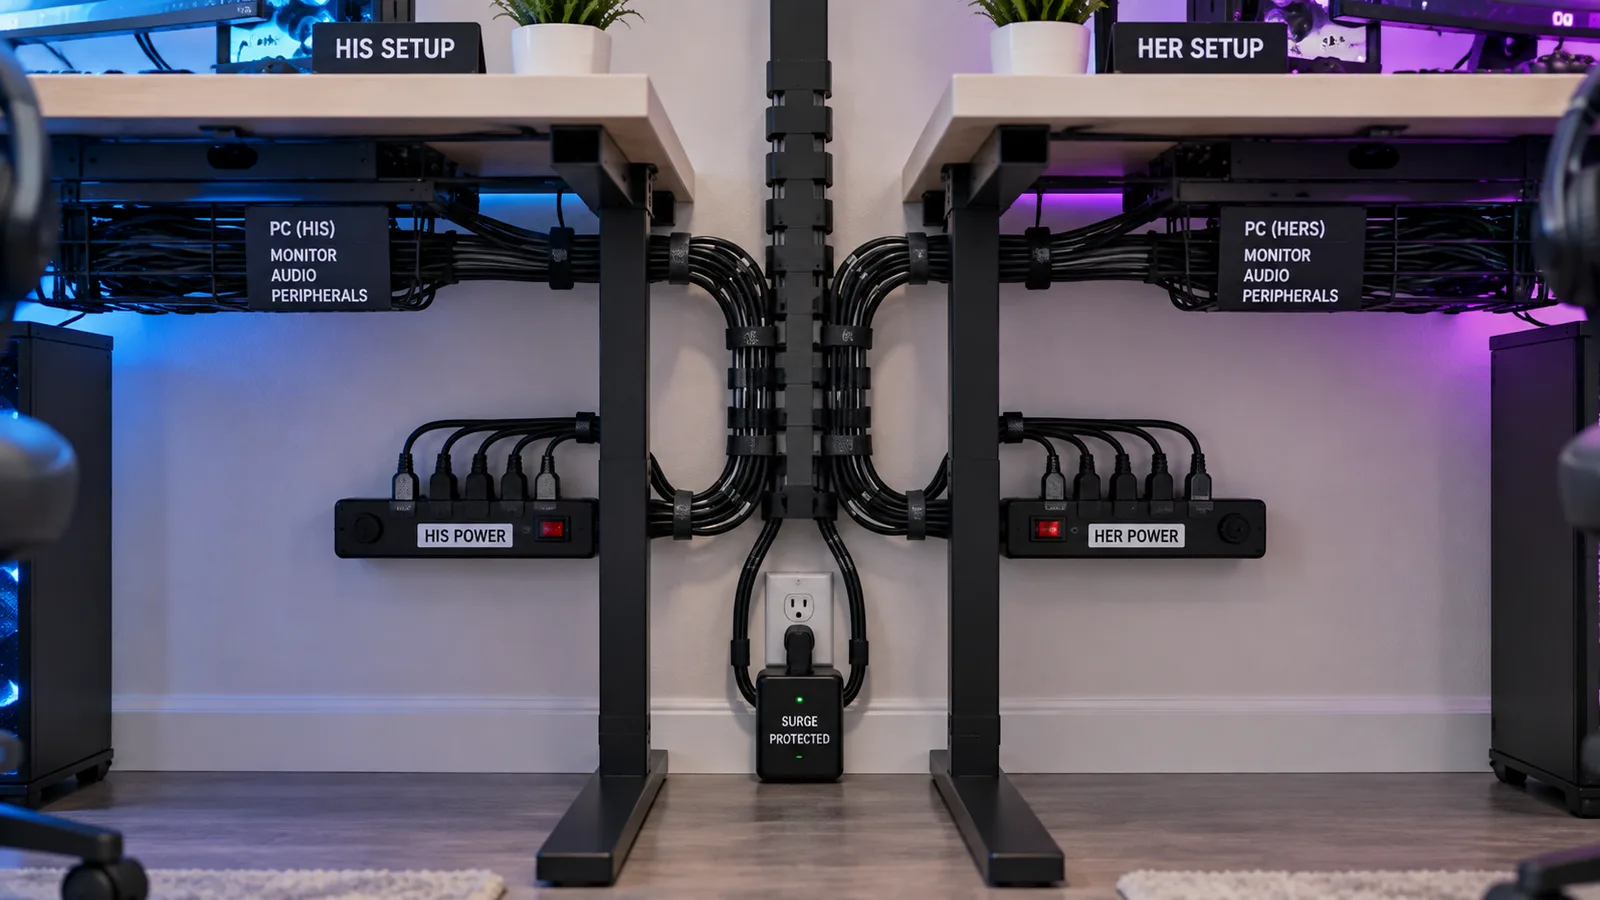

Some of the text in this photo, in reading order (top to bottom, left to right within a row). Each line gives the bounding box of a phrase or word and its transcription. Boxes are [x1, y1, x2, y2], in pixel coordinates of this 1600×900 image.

[336, 37, 455, 60] HIS SETUP
[1138, 37, 1264, 60] HER SETUP
[269, 219, 336, 239] PC (HIS)
[1244, 219, 1326, 239] PC (HERS)
[270, 248, 337, 263] MONITOR
[1243, 248, 1311, 263] MONITOR
[270, 268, 317, 282] AUDIO
[1243, 268, 1290, 283] AUDIO
[271, 288, 368, 304] PERIPHERALS
[1242, 288, 1339, 304] PERIPHERALS
[425, 529, 506, 543] HIS POWER
[1094, 529, 1179, 543] HER POWER
[769, 715, 830, 746] SURGE PROTECTED
